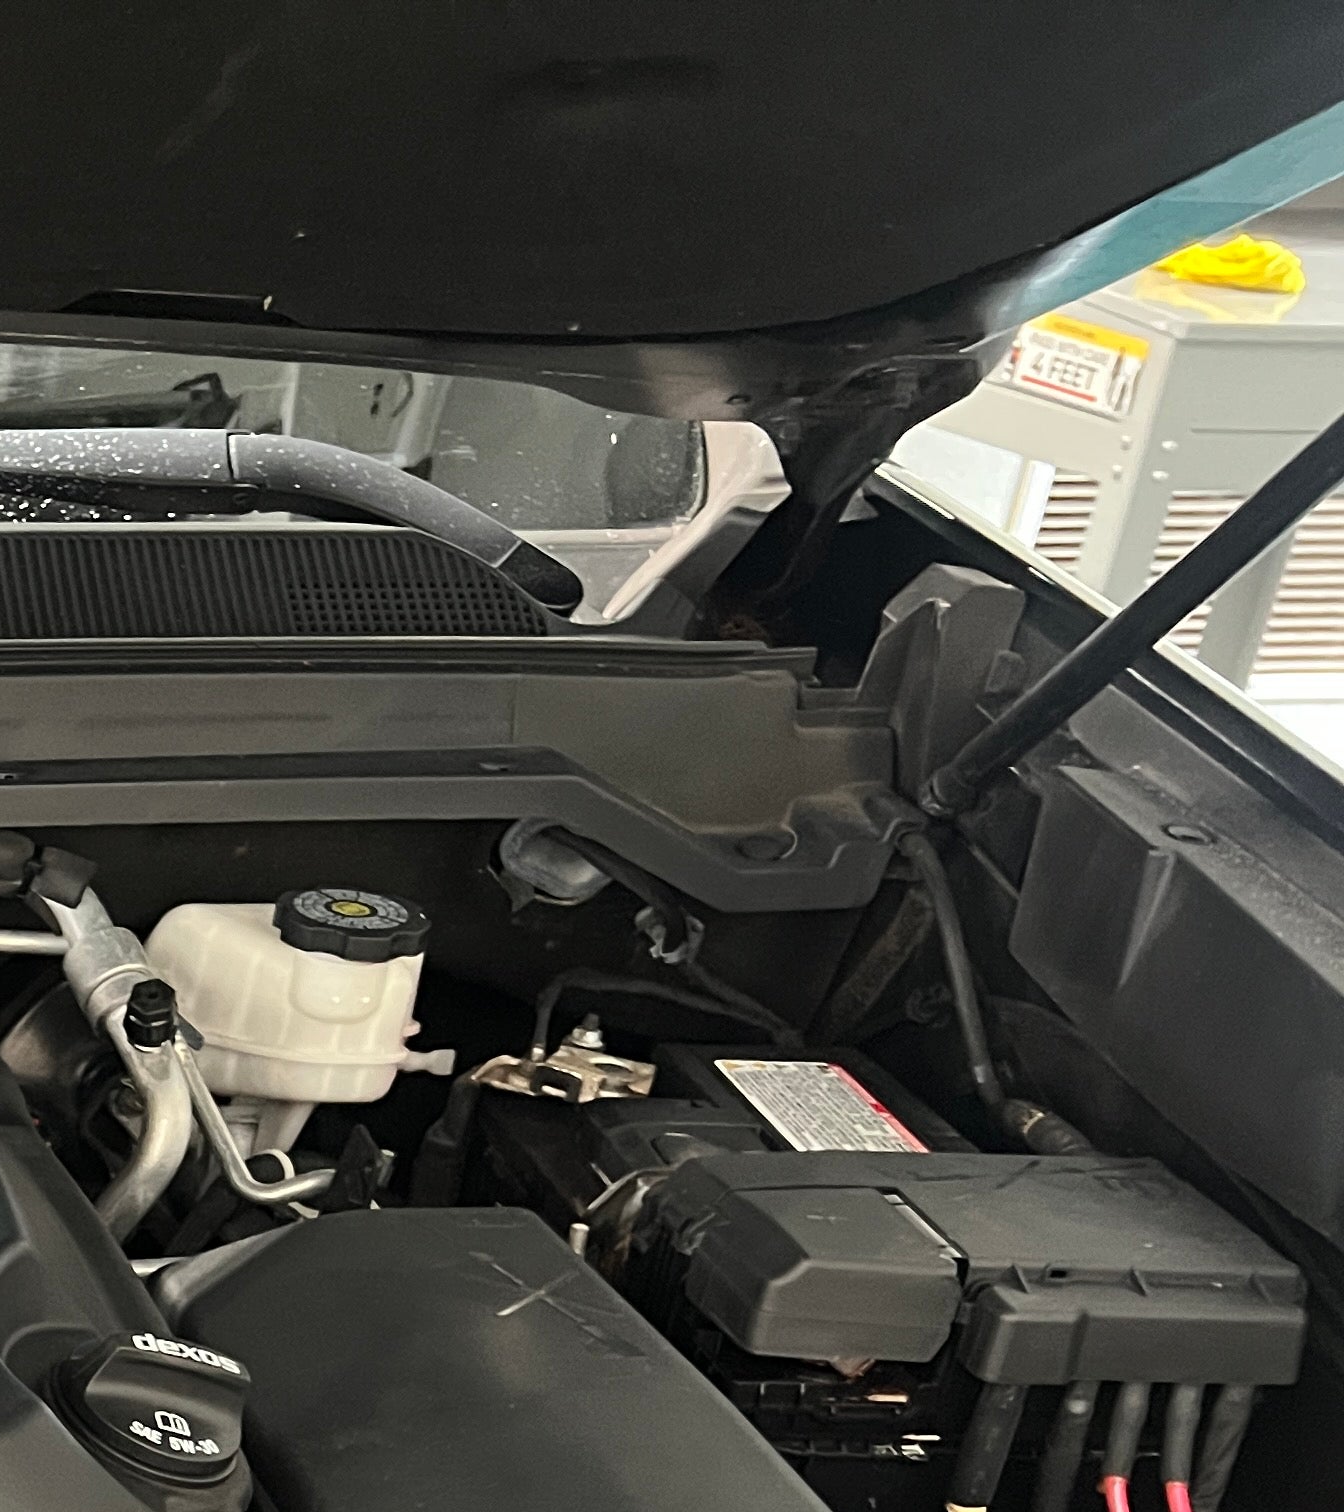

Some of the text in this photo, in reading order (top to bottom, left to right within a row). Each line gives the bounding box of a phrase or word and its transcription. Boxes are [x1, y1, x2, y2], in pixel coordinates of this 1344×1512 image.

[1047, 355, 1100, 389] FEET
[131, 1332, 242, 1375] dexos
[129, 1420, 220, 1456] SAE 5W-30
